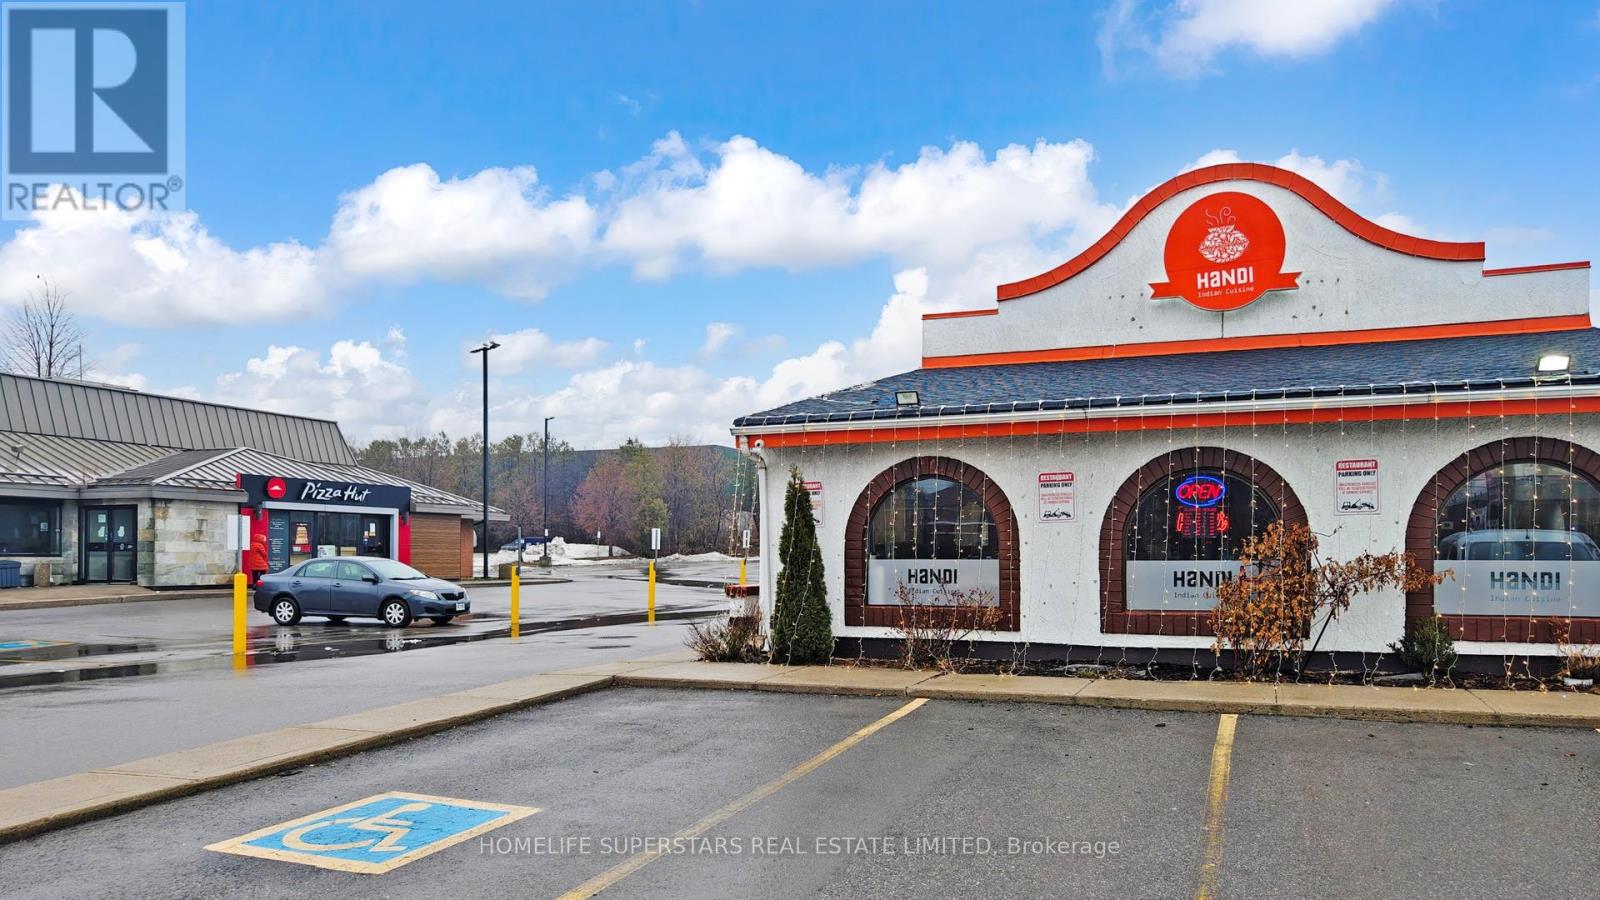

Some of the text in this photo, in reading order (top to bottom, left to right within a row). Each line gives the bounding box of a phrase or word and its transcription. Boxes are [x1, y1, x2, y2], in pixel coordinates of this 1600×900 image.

[1198, 286, 1255, 298] Indian Cuisine
[1338, 461, 1376, 470] RESTAURANT
[301, 481, 372, 502] Pizza Hut
[1179, 483, 1222, 499] OPEN
